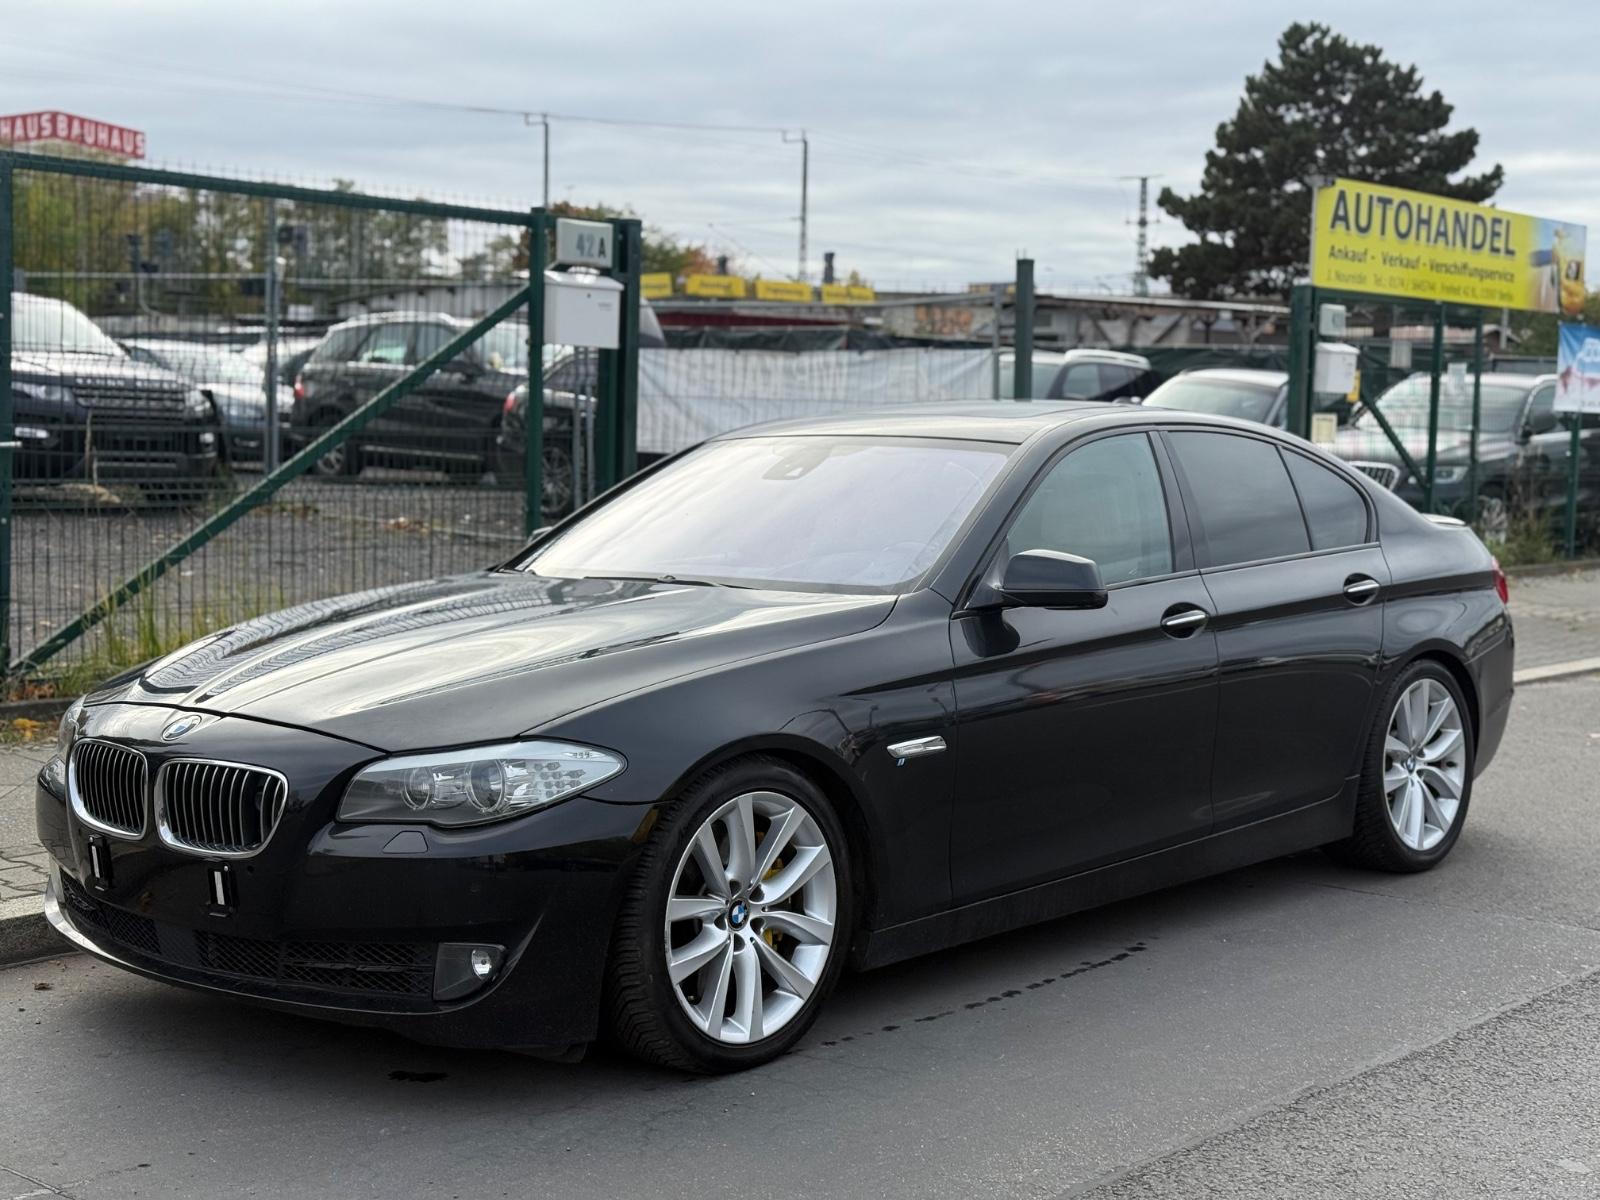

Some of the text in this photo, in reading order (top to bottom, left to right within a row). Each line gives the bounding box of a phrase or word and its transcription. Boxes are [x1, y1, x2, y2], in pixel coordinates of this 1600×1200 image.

[0, 112, 144, 155] HAUS BAUHAUS
[1330, 190, 1515, 256] AUTOHANDEL
[1329, 245, 1368, 264] Ankauf
[1382, 252, 1421, 271] Verkauf
